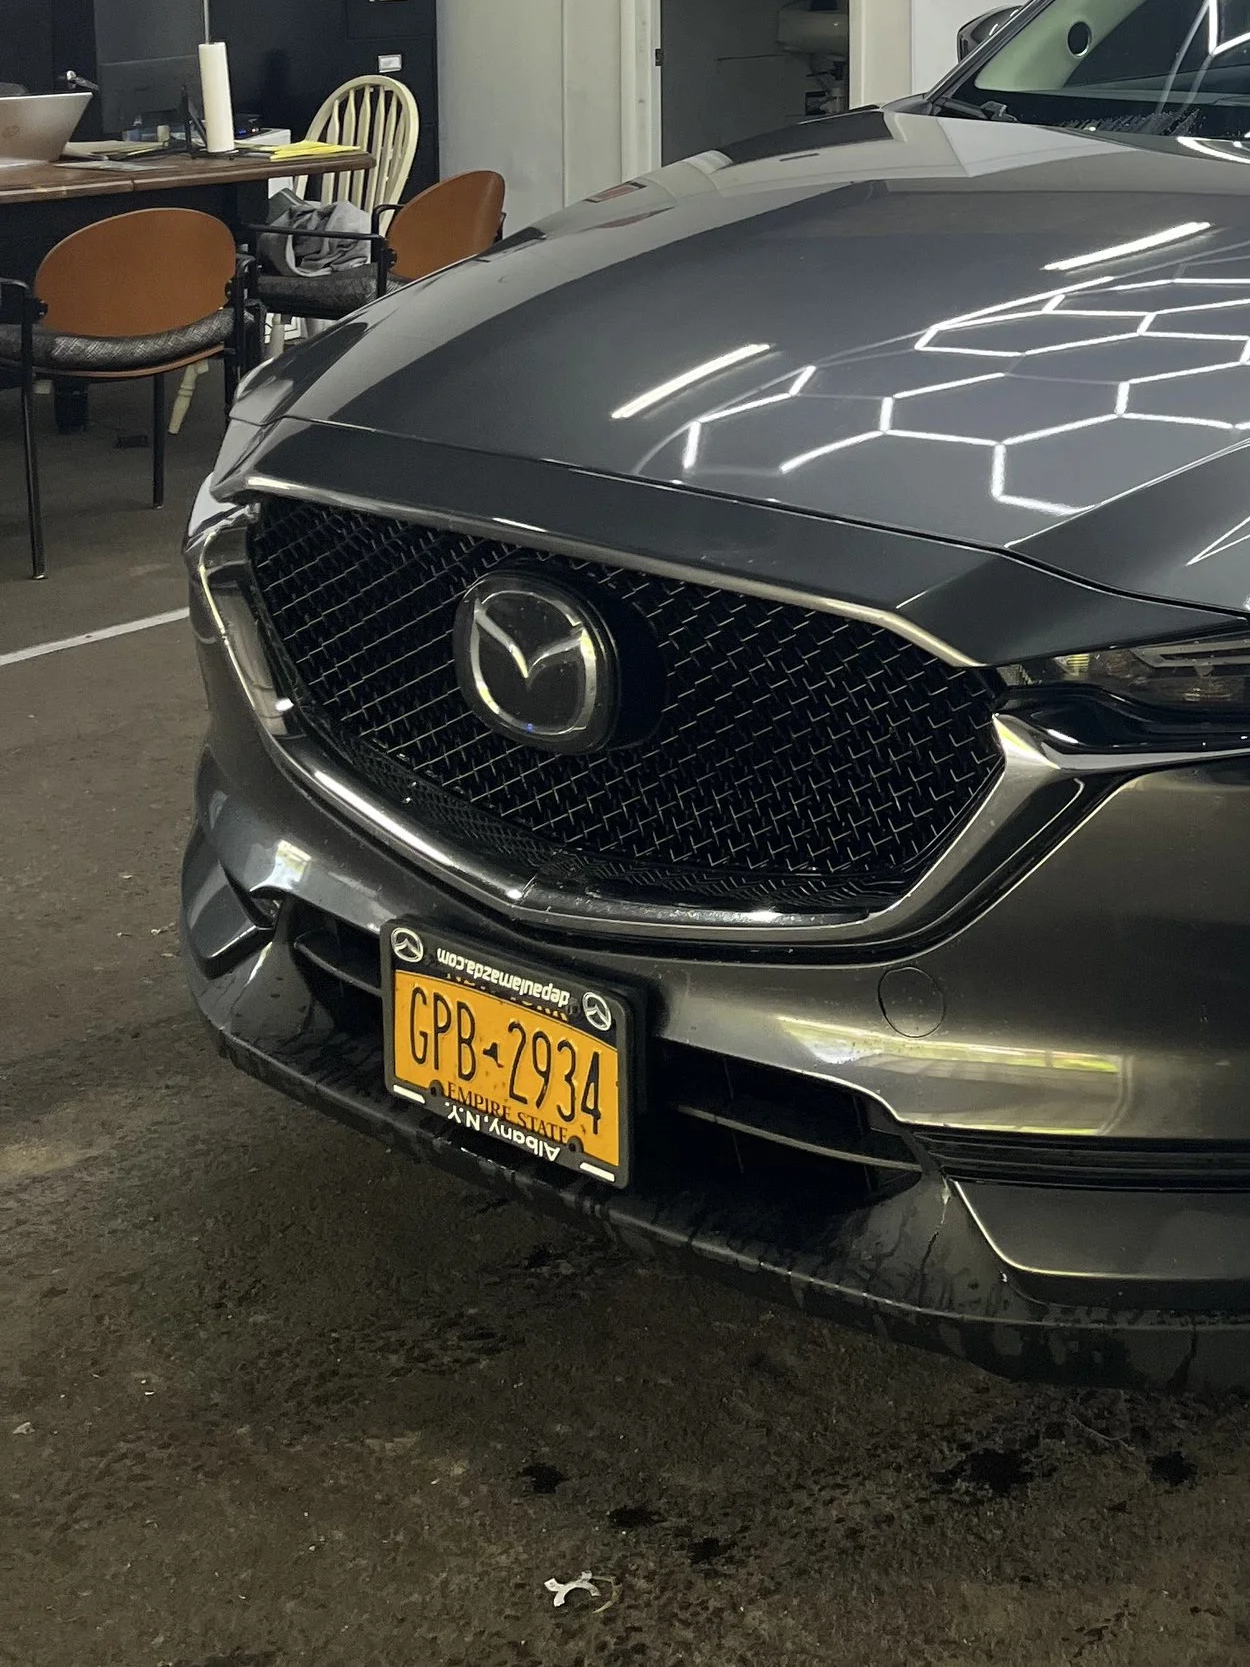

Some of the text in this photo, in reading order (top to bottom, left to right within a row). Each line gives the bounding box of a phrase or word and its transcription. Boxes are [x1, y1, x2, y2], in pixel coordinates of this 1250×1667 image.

[436, 947, 570, 1008] depaulamazda.com
[409, 986, 602, 1135] GPB 2934
[445, 1102, 481, 1132] N.Y.
[447, 1081, 568, 1143] EMPIRE STATE
